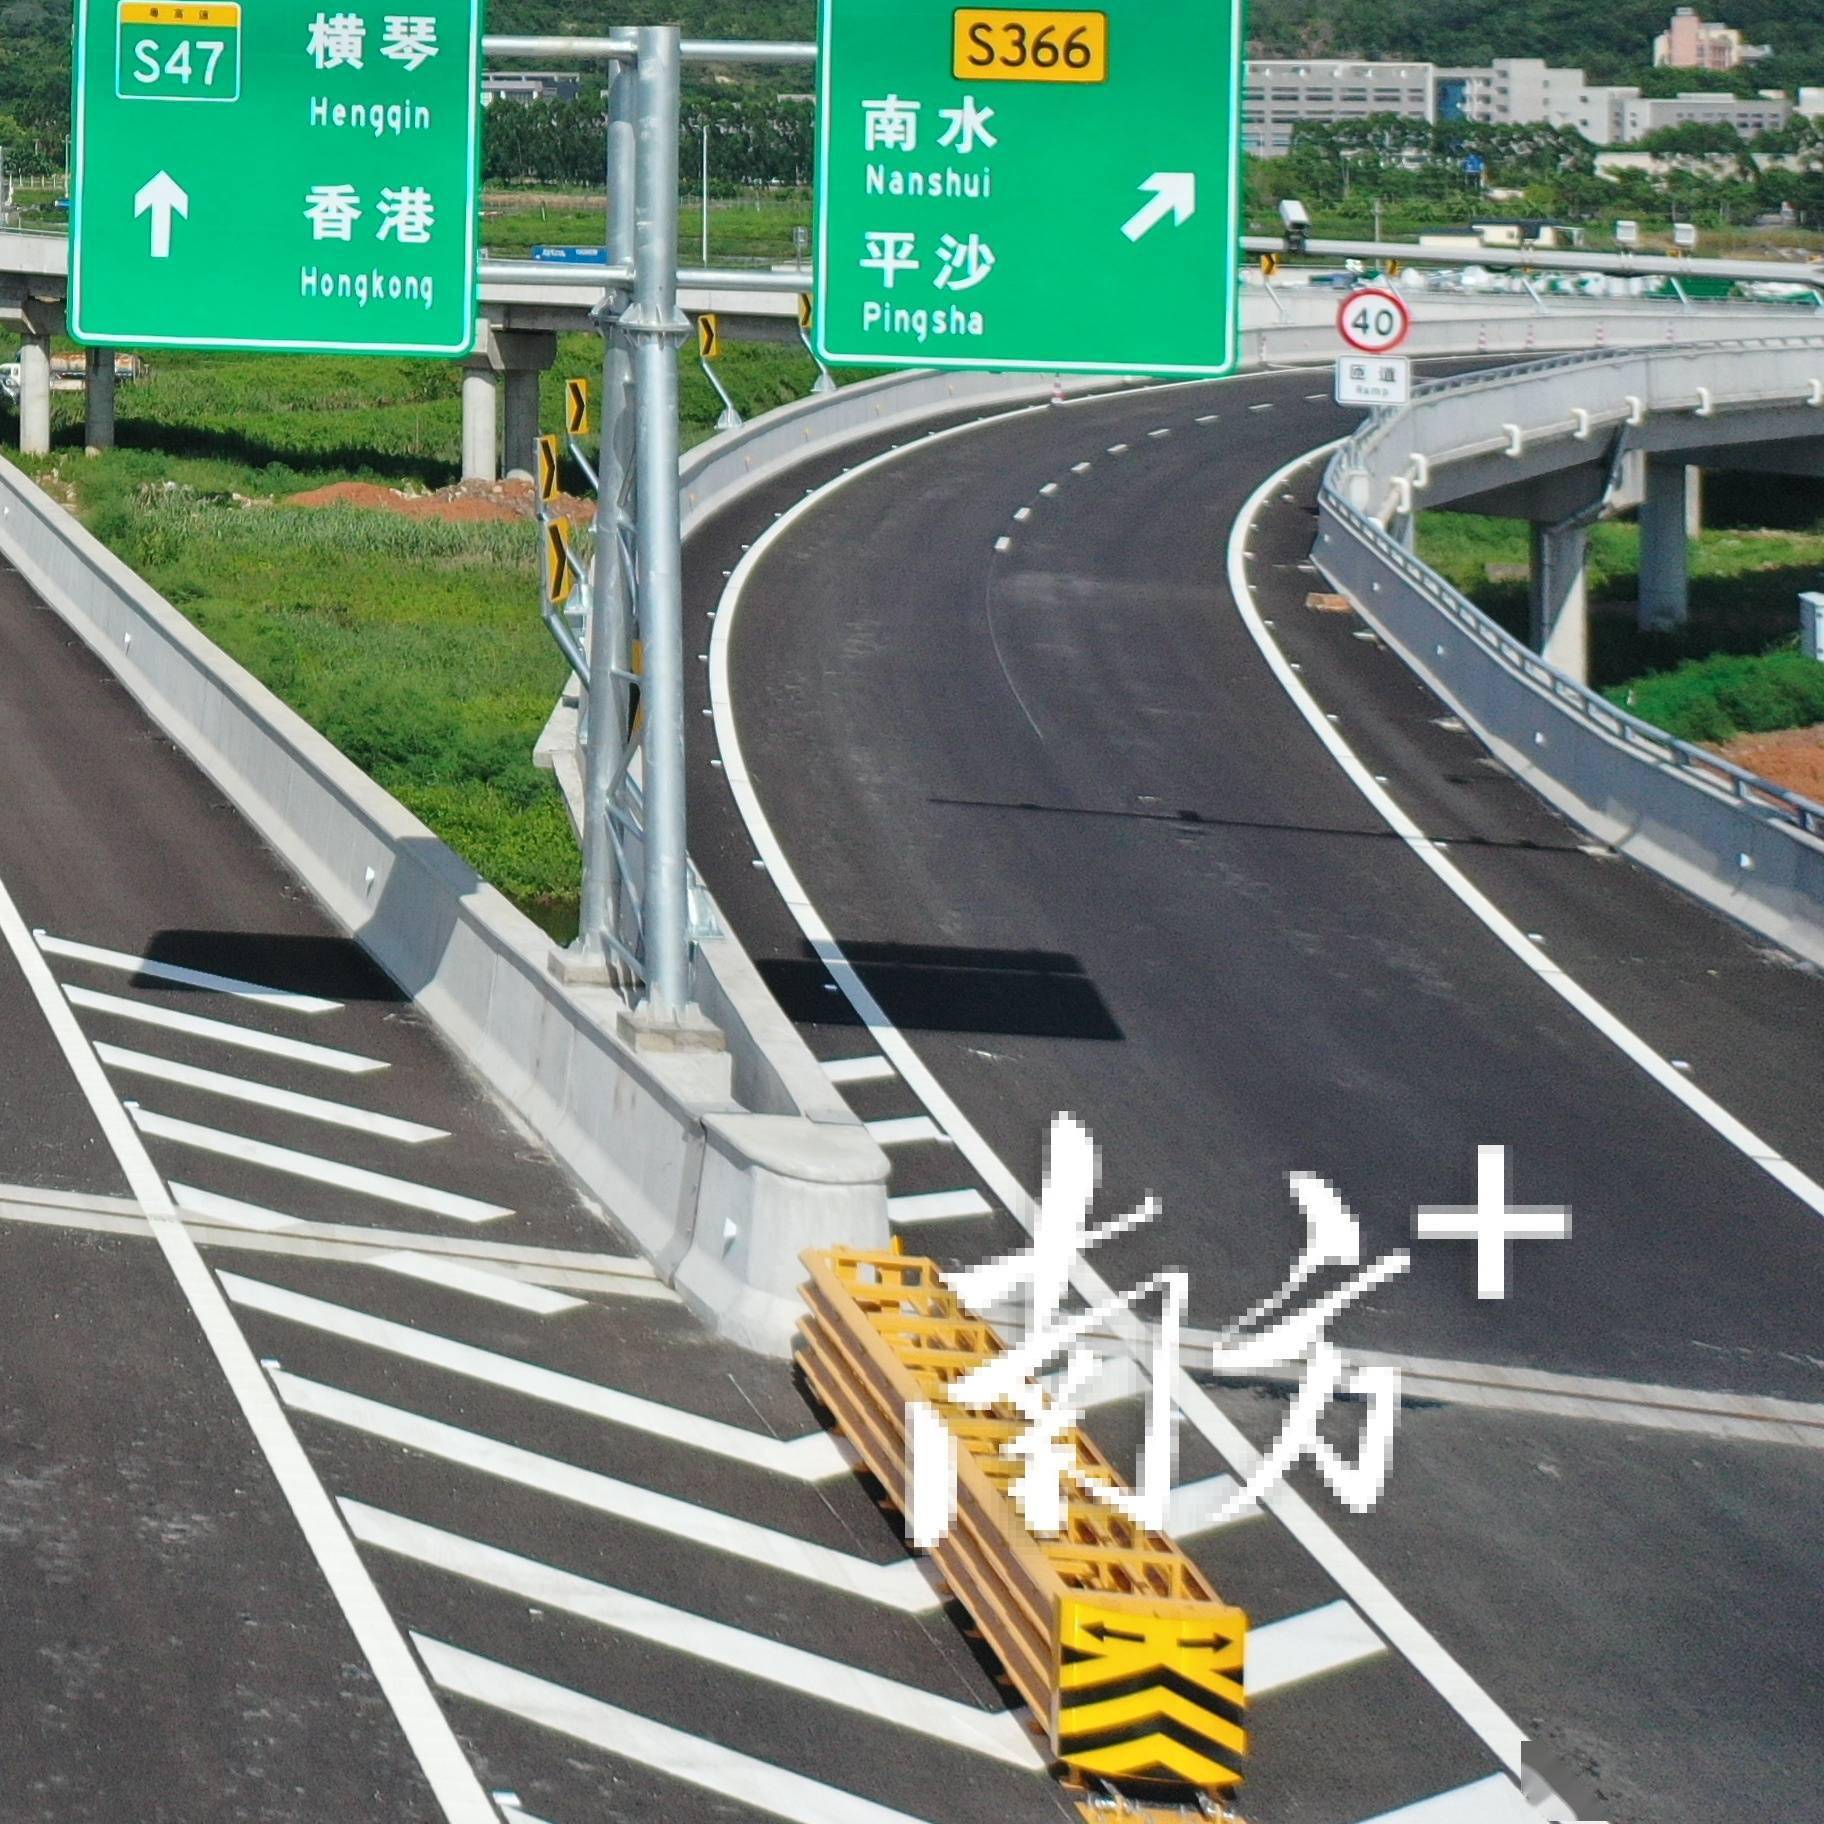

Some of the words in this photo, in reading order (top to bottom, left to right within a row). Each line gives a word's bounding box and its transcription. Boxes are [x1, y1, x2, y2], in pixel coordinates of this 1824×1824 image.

[133, 39, 225, 85] S47
[306, 12, 440, 71] 横琴
[967, 21, 1092, 70] S366
[309, 96, 430, 137] Hengqin
[861, 93, 998, 154] 南水
[865, 164, 991, 198] Nanshui
[303, 184, 435, 244] 香港
[859, 231, 996, 291] 平沙
[300, 266, 434, 309] Hongkong
[862, 302, 984, 343] Pingsha
[1351, 307, 1394, 336] 40
